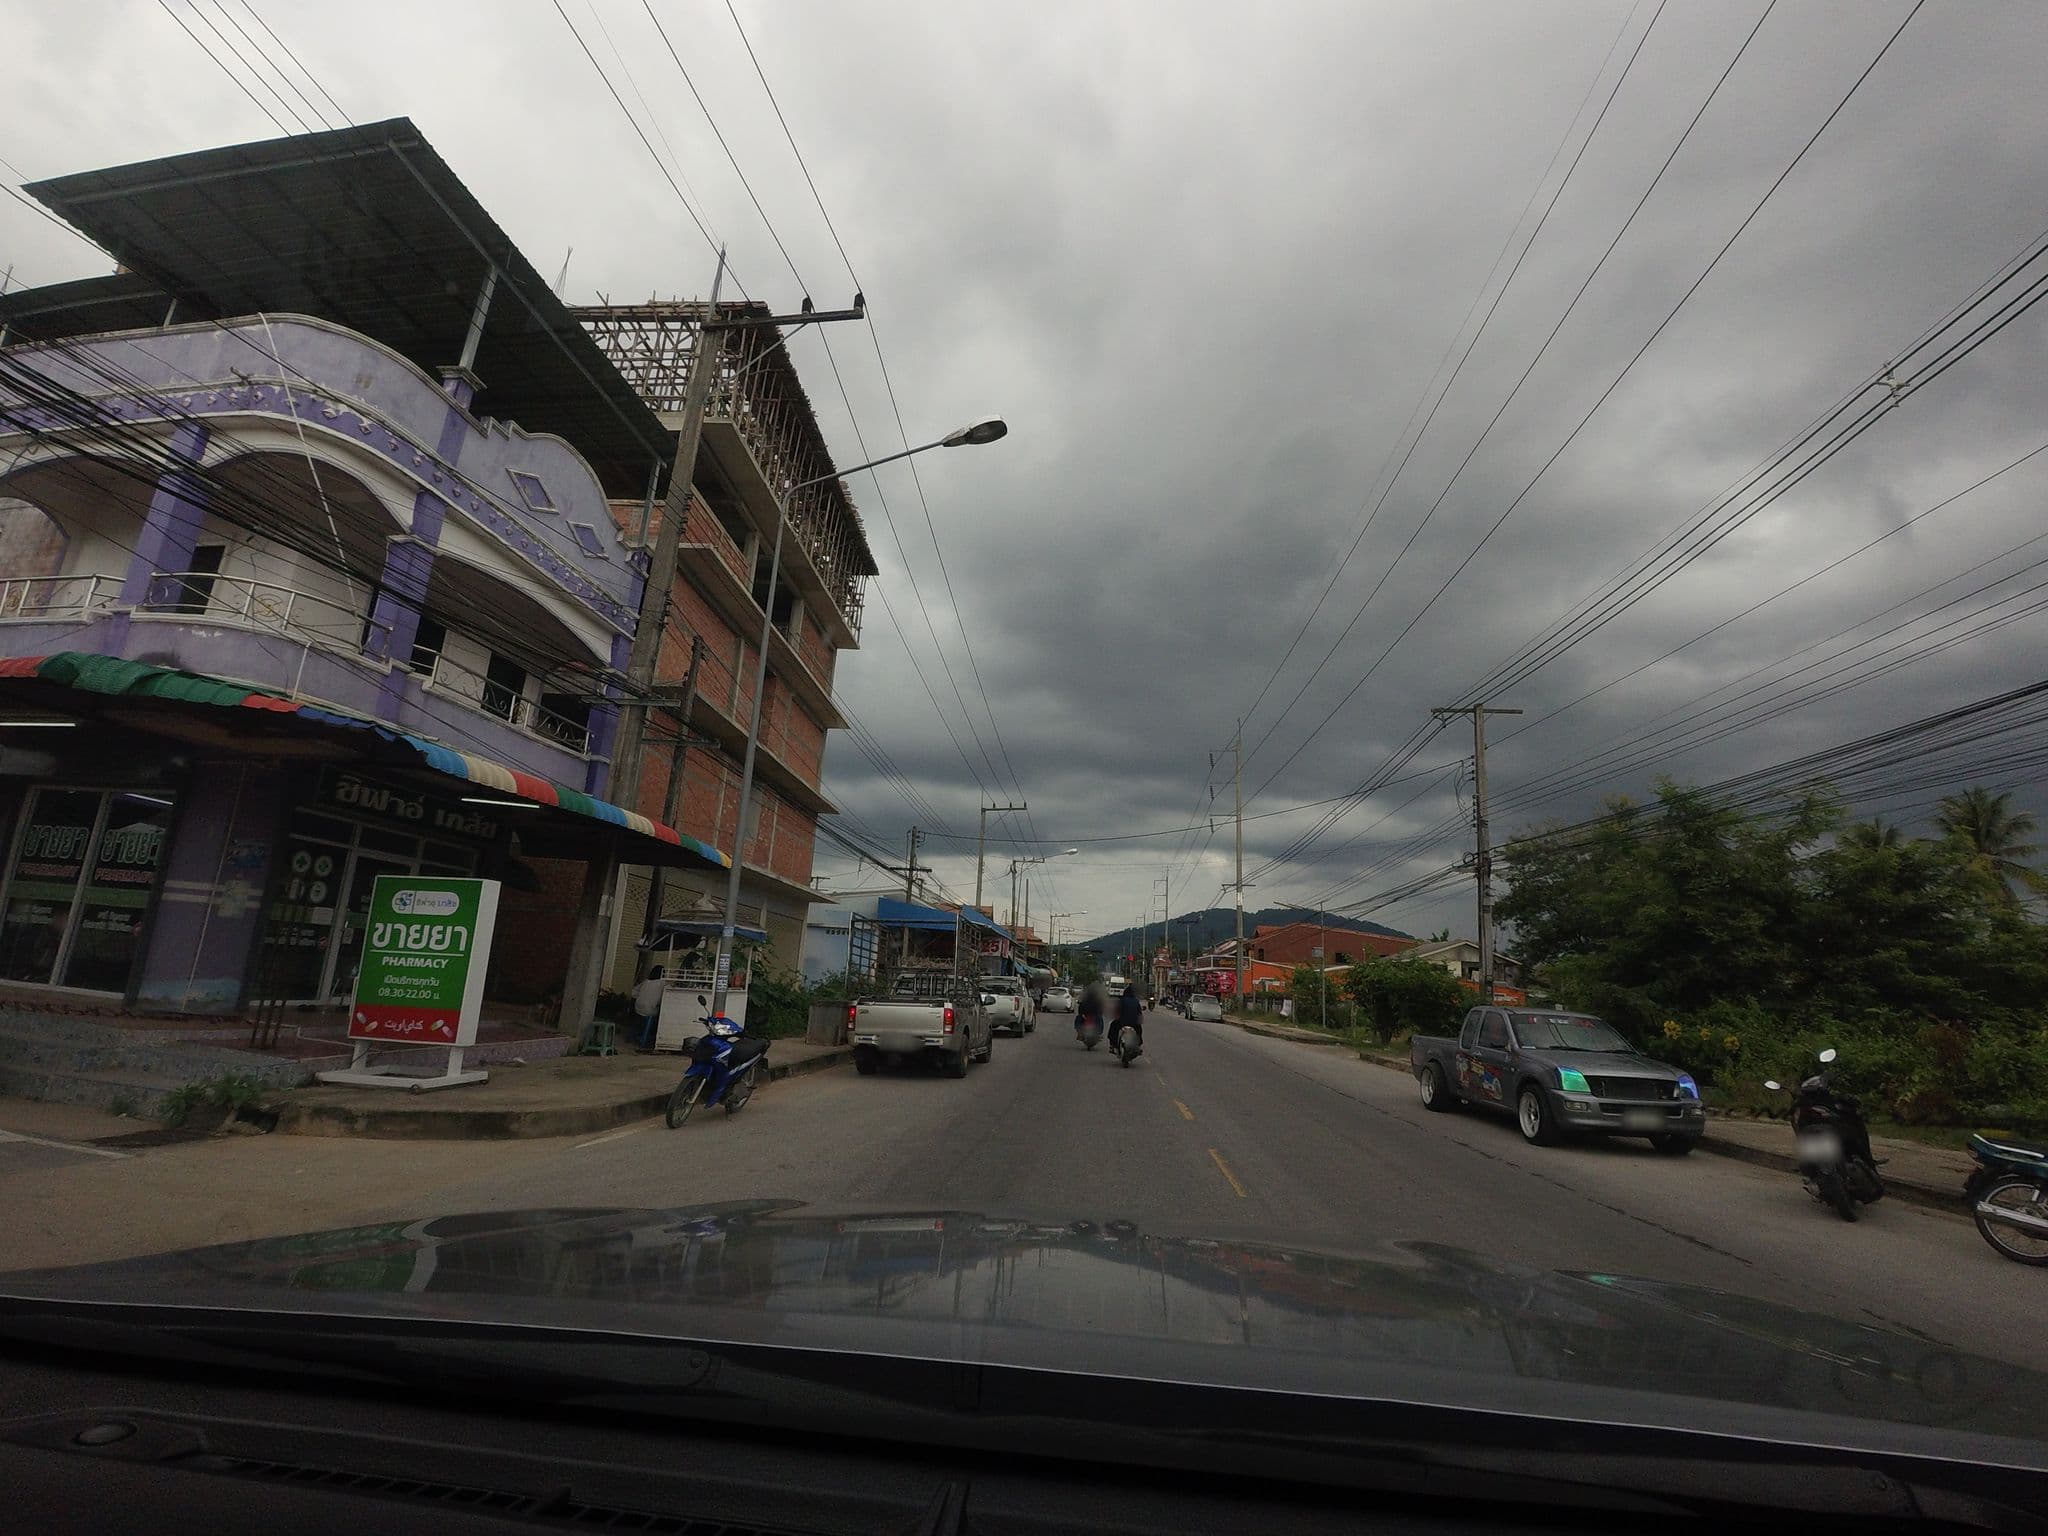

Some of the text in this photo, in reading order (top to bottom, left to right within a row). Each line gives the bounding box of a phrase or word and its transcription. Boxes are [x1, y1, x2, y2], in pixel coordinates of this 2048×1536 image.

[372, 922, 468, 951] ขายยา
[381, 956, 449, 969] PHARMACY
[383, 974, 440, 988] เปิดบริการทุกวัน
[378, 987, 431, 999] 08.30-22.00
